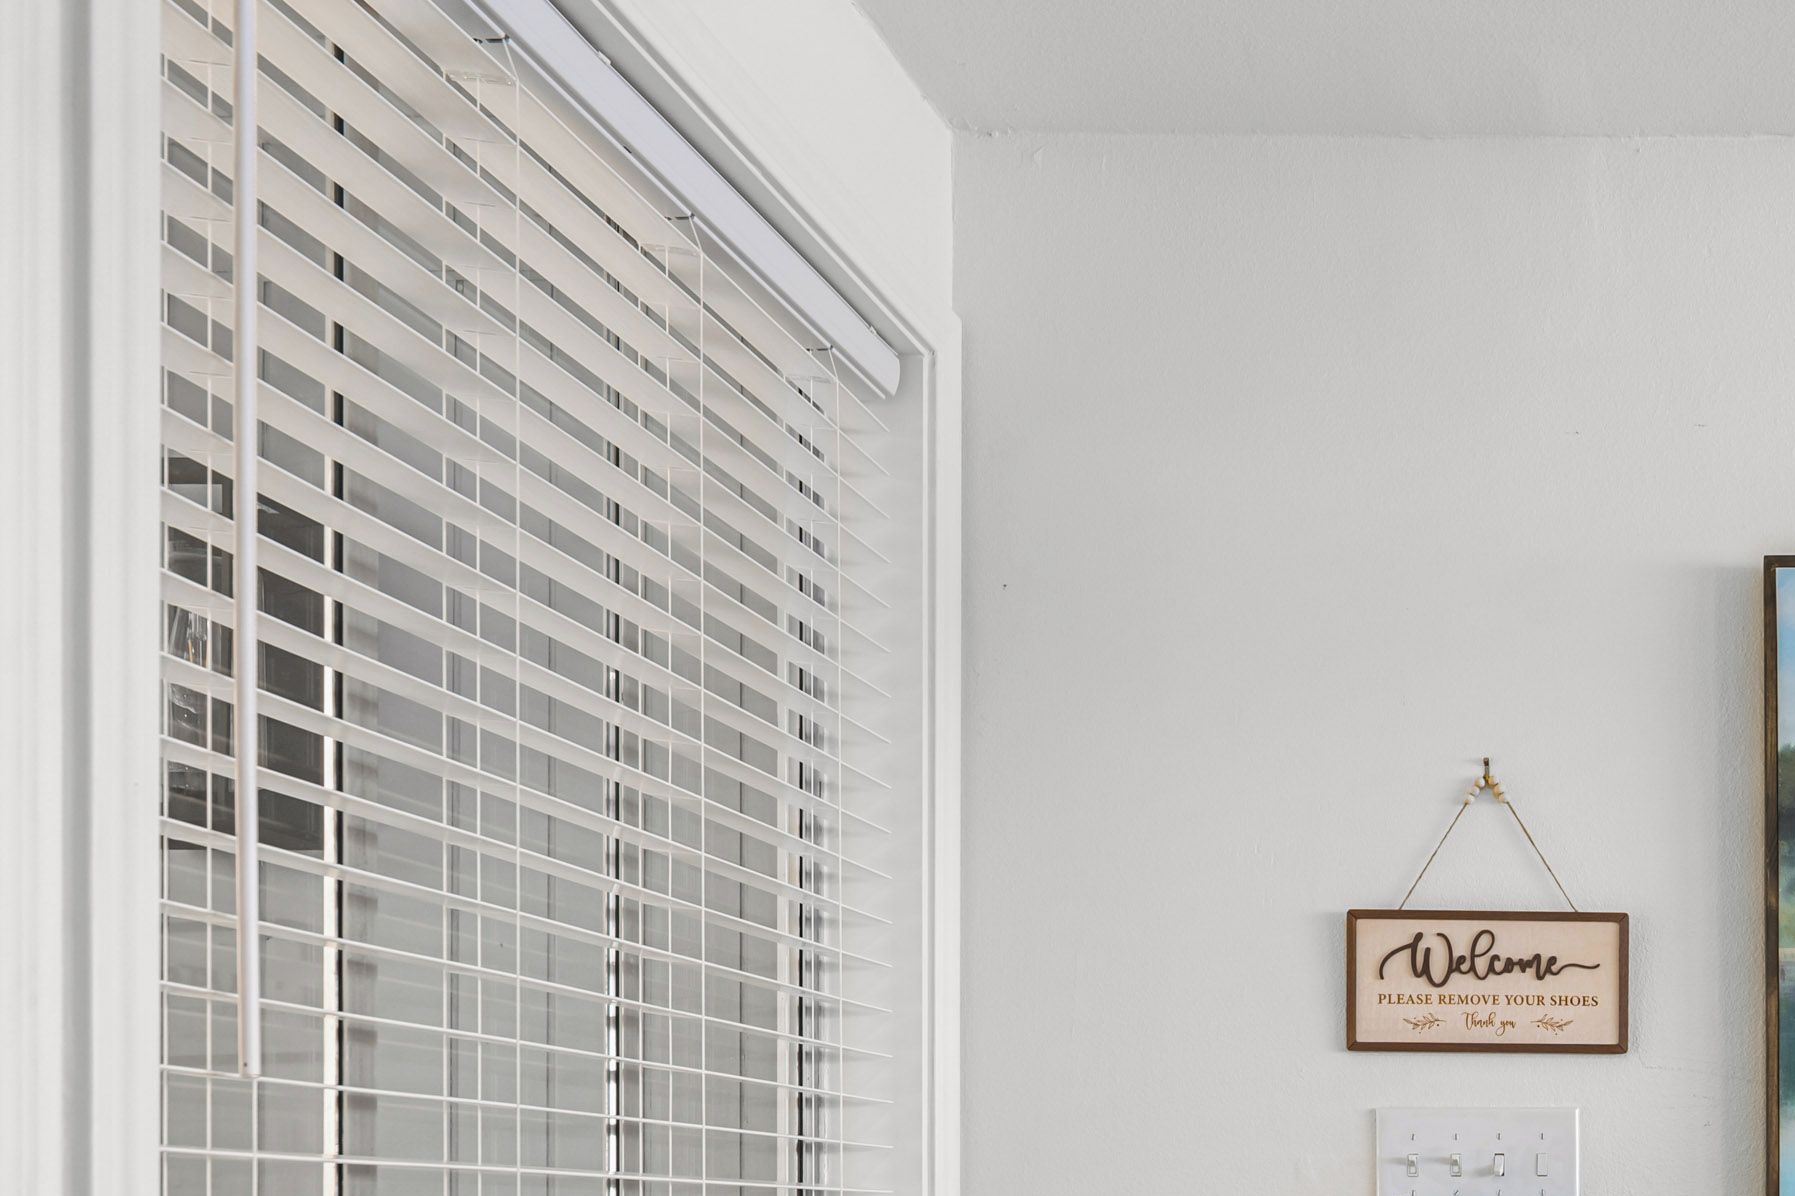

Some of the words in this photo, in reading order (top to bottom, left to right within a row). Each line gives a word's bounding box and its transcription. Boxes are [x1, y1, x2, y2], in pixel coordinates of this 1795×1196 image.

[1379, 929, 1601, 987] Welcome
[1377, 993, 1433, 1006] PLEASE
[1438, 993, 1500, 1006] REMOVE
[1504, 994, 1546, 1006] YOUR
[1550, 995, 1599, 1007] SHOES
[1463, 1011, 1496, 1030] Thank
[1496, 1020, 1517, 1036] you
